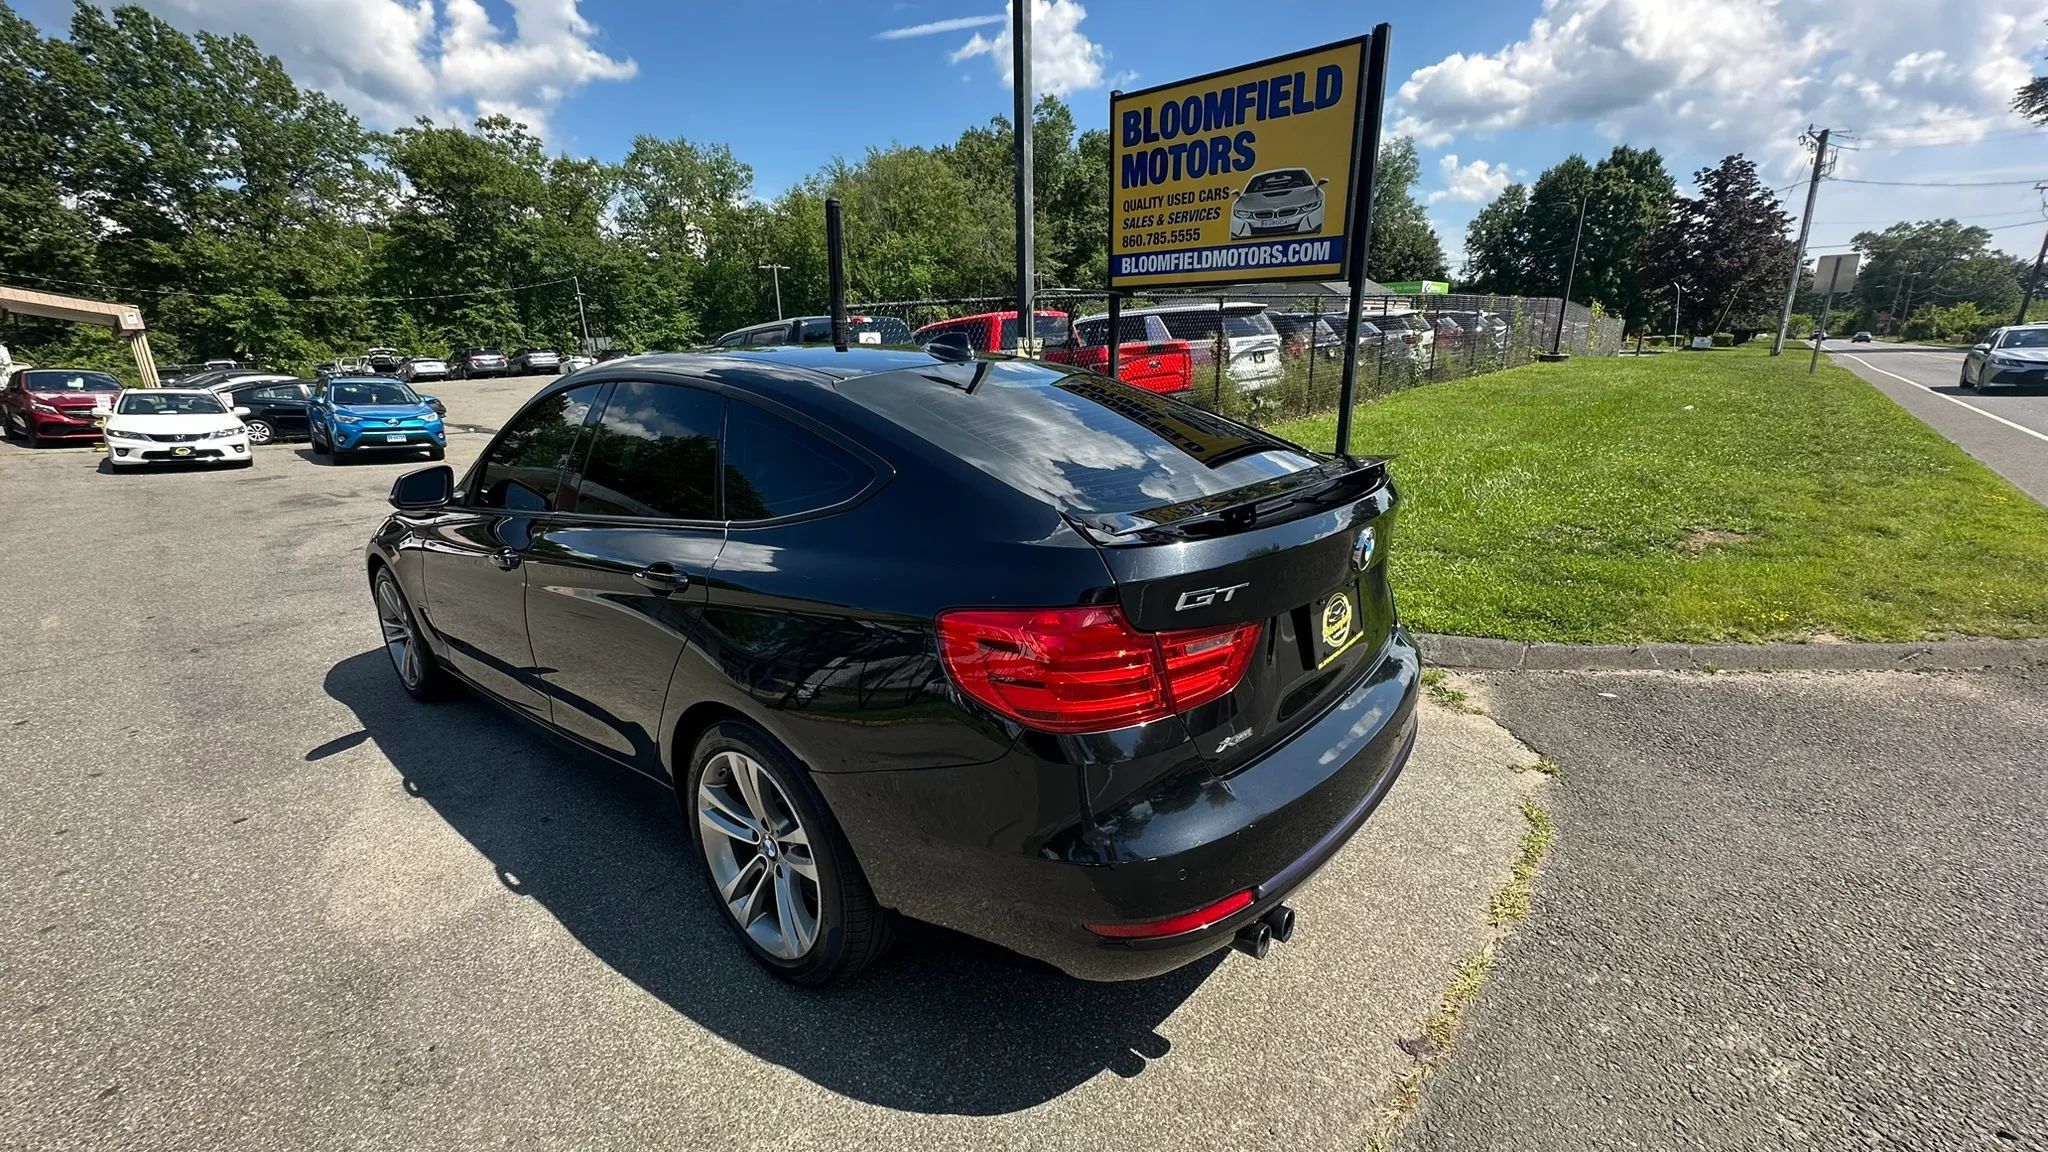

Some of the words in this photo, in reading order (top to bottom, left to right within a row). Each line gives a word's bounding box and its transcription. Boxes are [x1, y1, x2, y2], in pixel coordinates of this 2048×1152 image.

[1122, 64, 1343, 148] BLOOMFIELD
[1122, 130, 1256, 189] MOTORS
[1123, 196, 1164, 213] QUALITY
[1167, 190, 1195, 207] USED
[1199, 187, 1230, 203] CARS
[1122, 214, 1154, 230] SALES
[1156, 213, 1165, 226] &
[1167, 207, 1221, 224] SERVICES
[1122, 229, 1201, 248] 860.785.5555
[1121, 241, 1331, 275] BLOOMFIELDMOTORS.COM
[1175, 582, 1250, 612] GT
